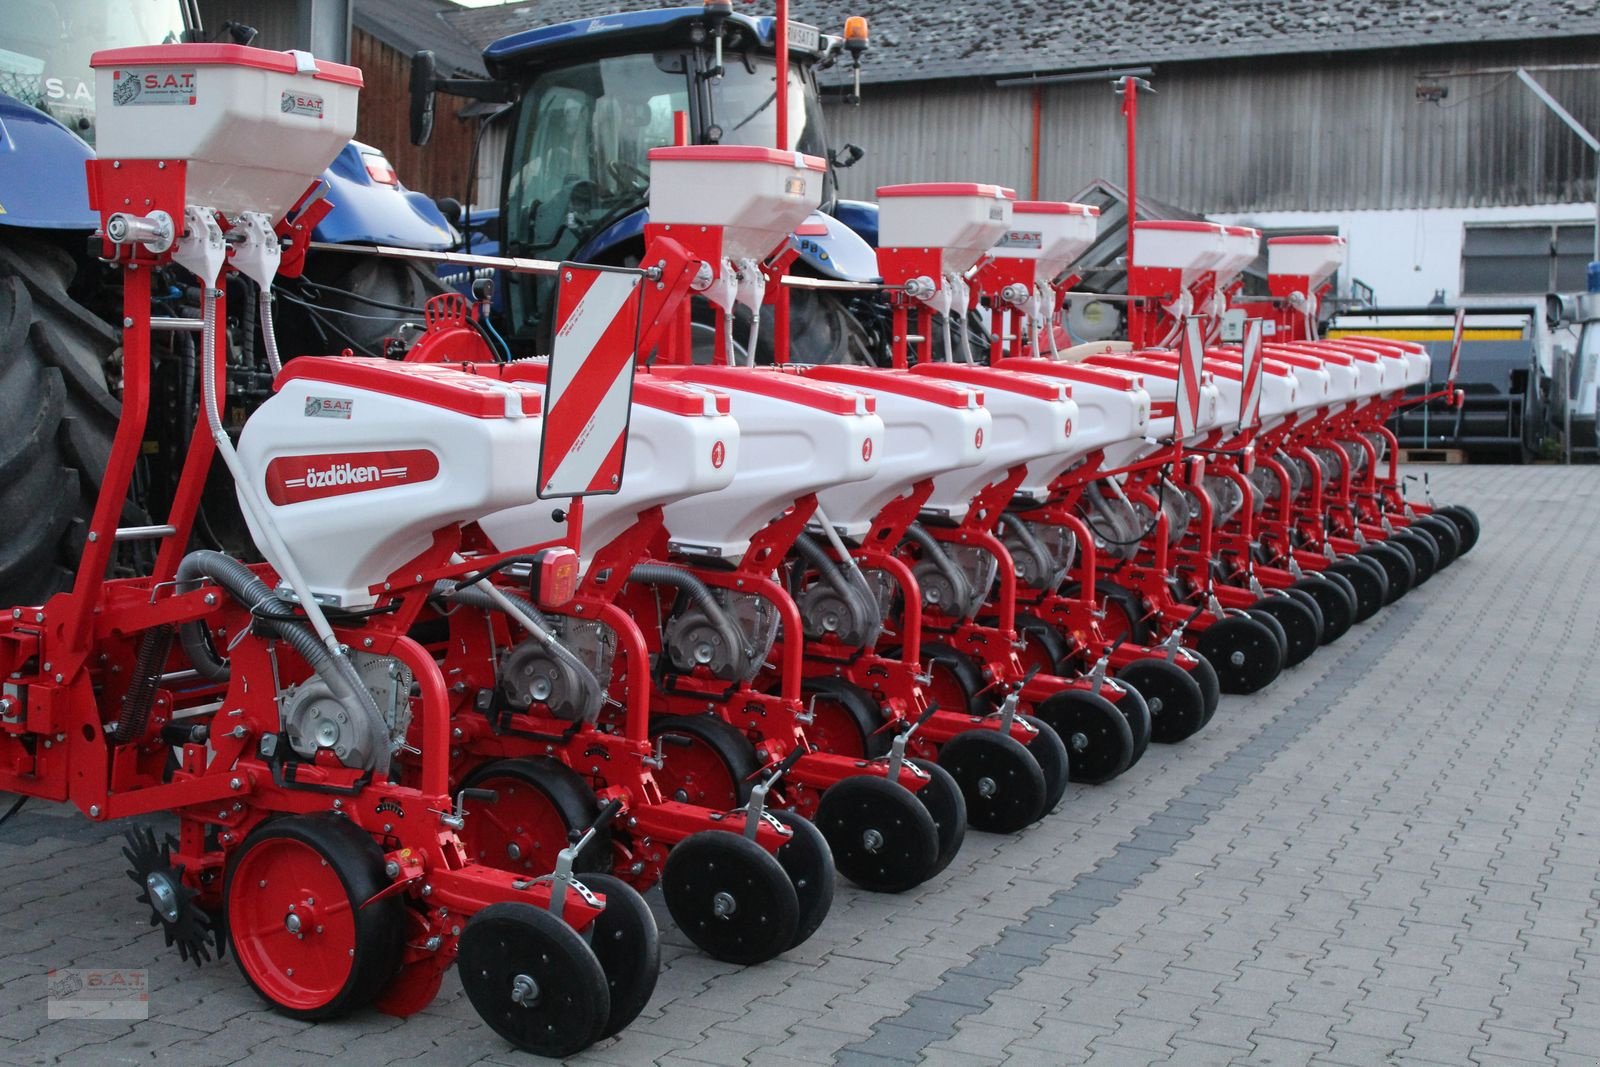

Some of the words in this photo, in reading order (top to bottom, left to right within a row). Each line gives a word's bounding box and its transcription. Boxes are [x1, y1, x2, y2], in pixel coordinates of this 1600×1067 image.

[144, 73, 194, 89] S.A.T.
[306, 463, 380, 488] özdöken
[602, 633, 611, 648] A
[395, 671, 405, 688] A
